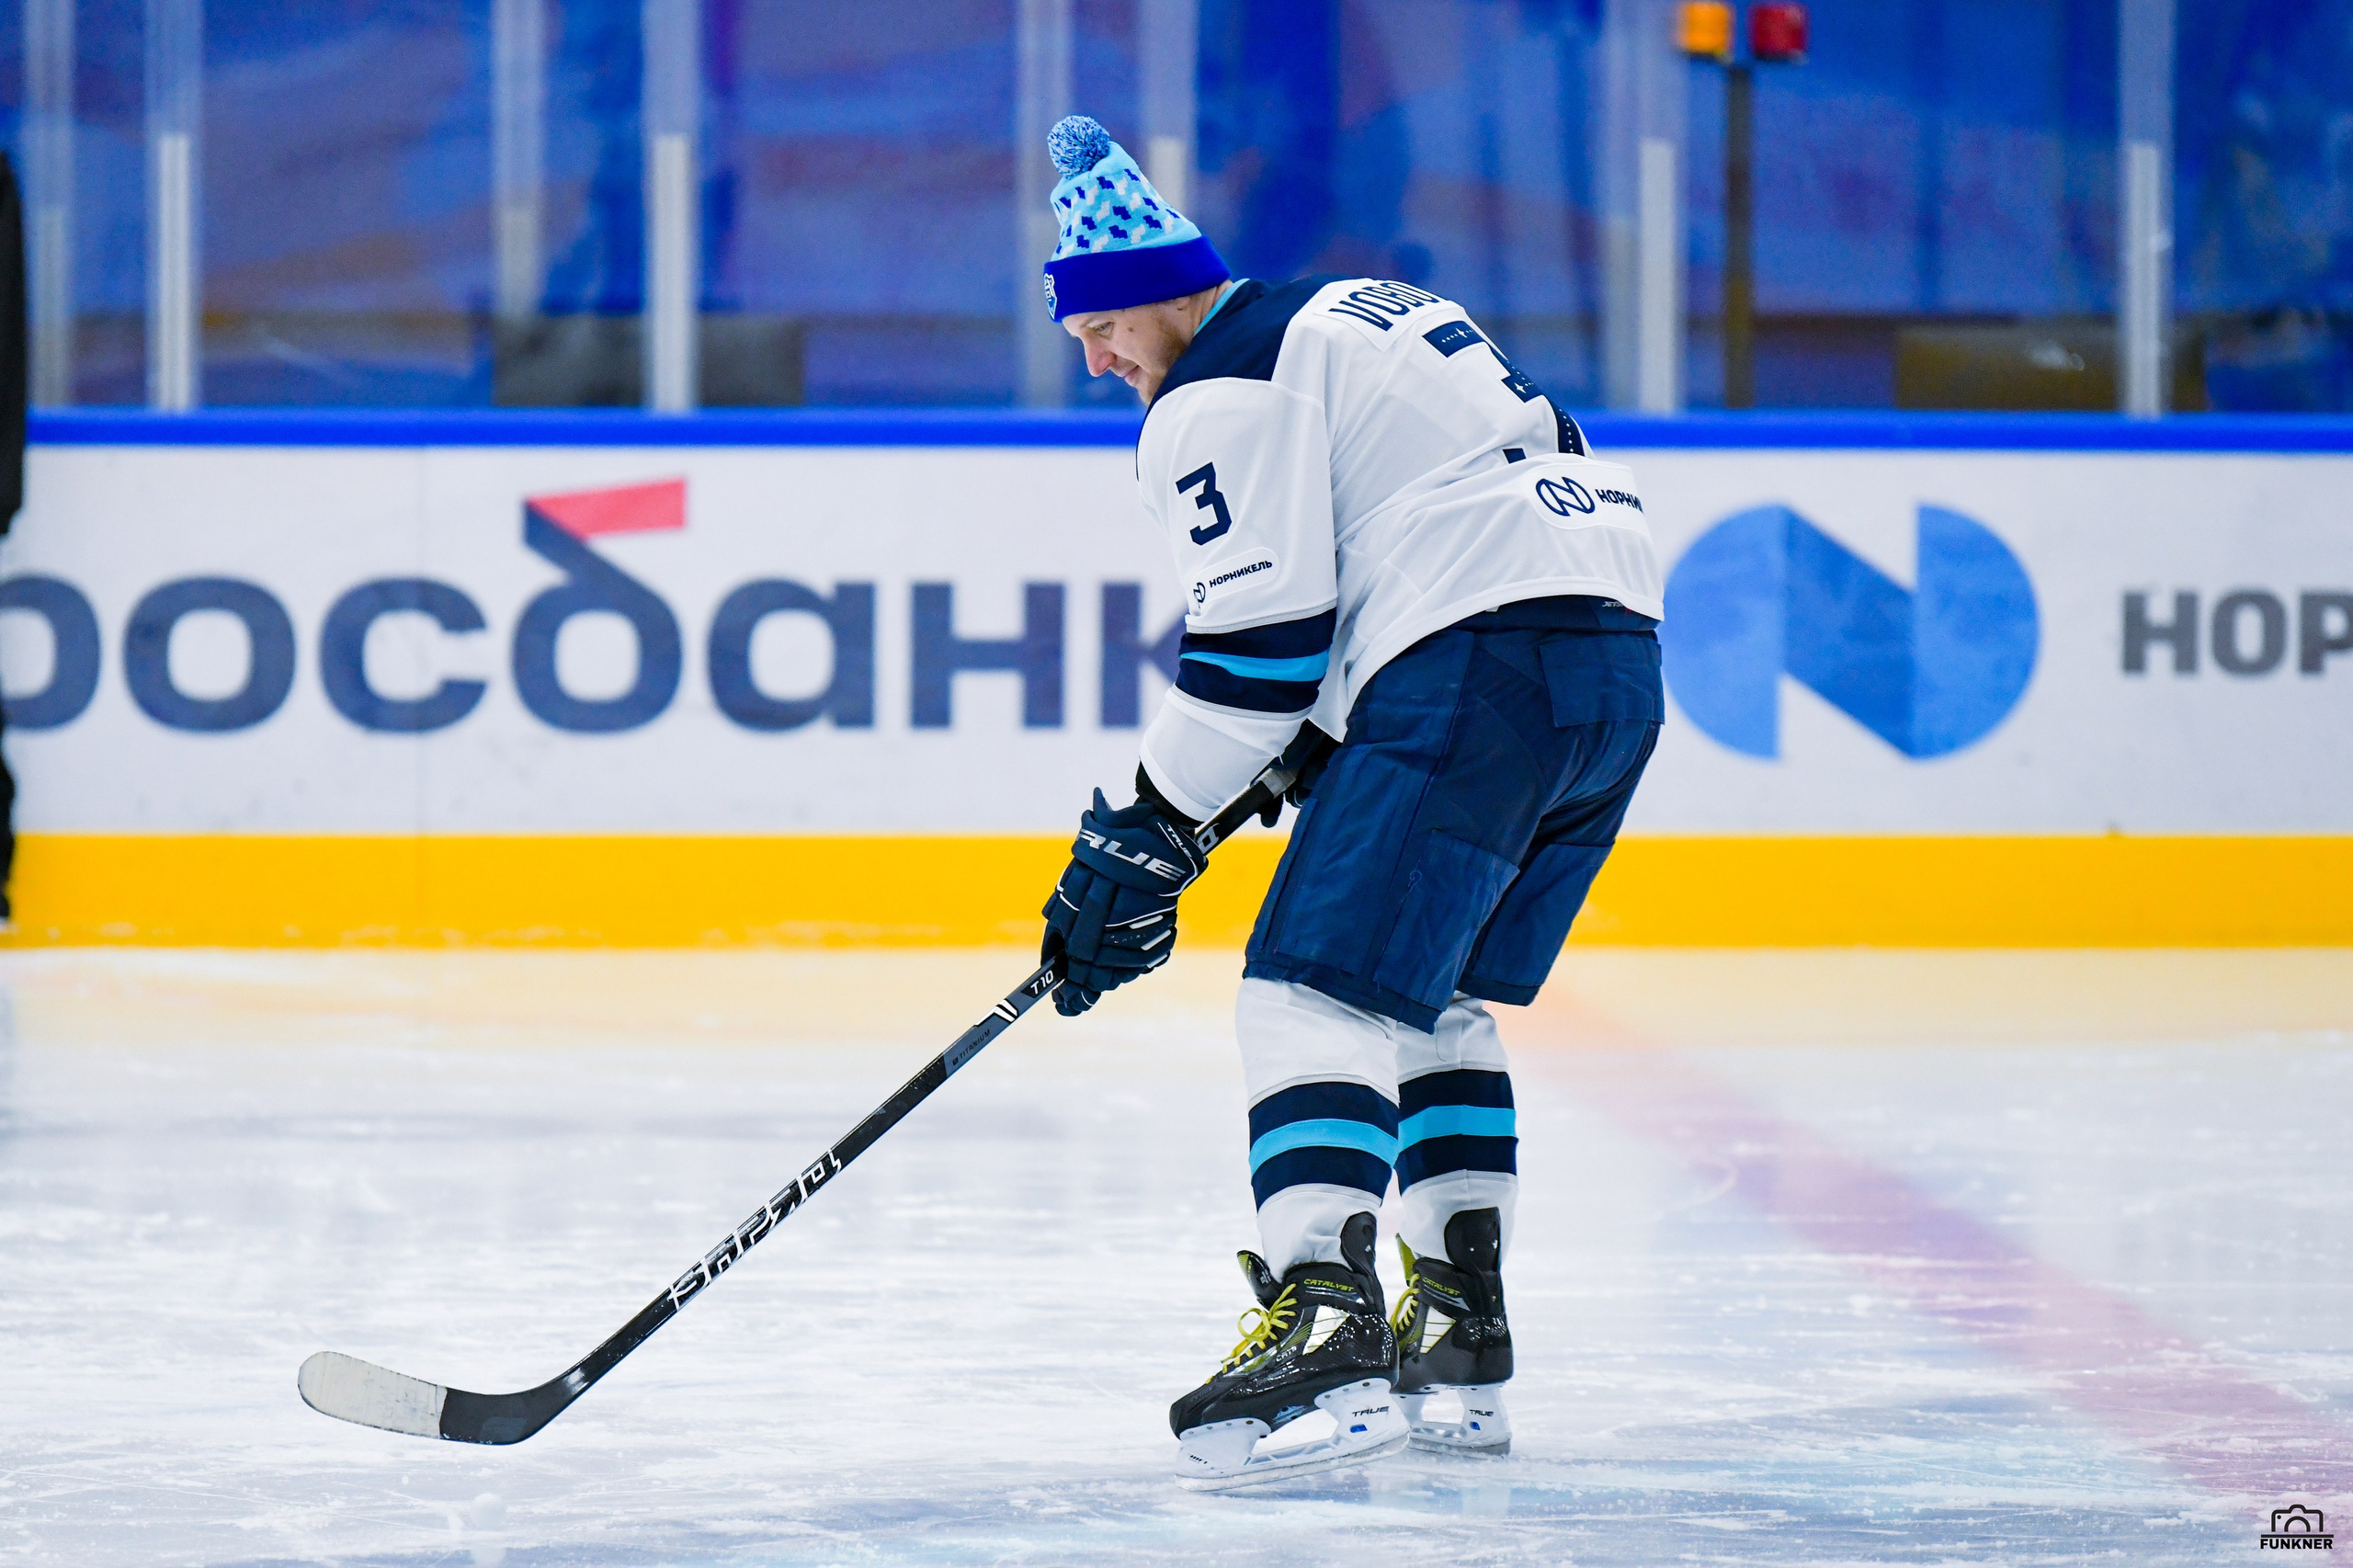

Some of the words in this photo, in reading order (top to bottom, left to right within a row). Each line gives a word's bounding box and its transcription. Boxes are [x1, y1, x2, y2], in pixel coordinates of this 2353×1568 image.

[1175, 461, 1233, 546] 3
[1209, 560, 1273, 588] НОРНИКЕЛЬ
[959, 1028, 991, 1060] TITANIUM
[1303, 1278, 1355, 1292] CATALYST
[1351, 1405, 1390, 1417] TRUE
[1469, 1409, 1495, 1417] TRUE
